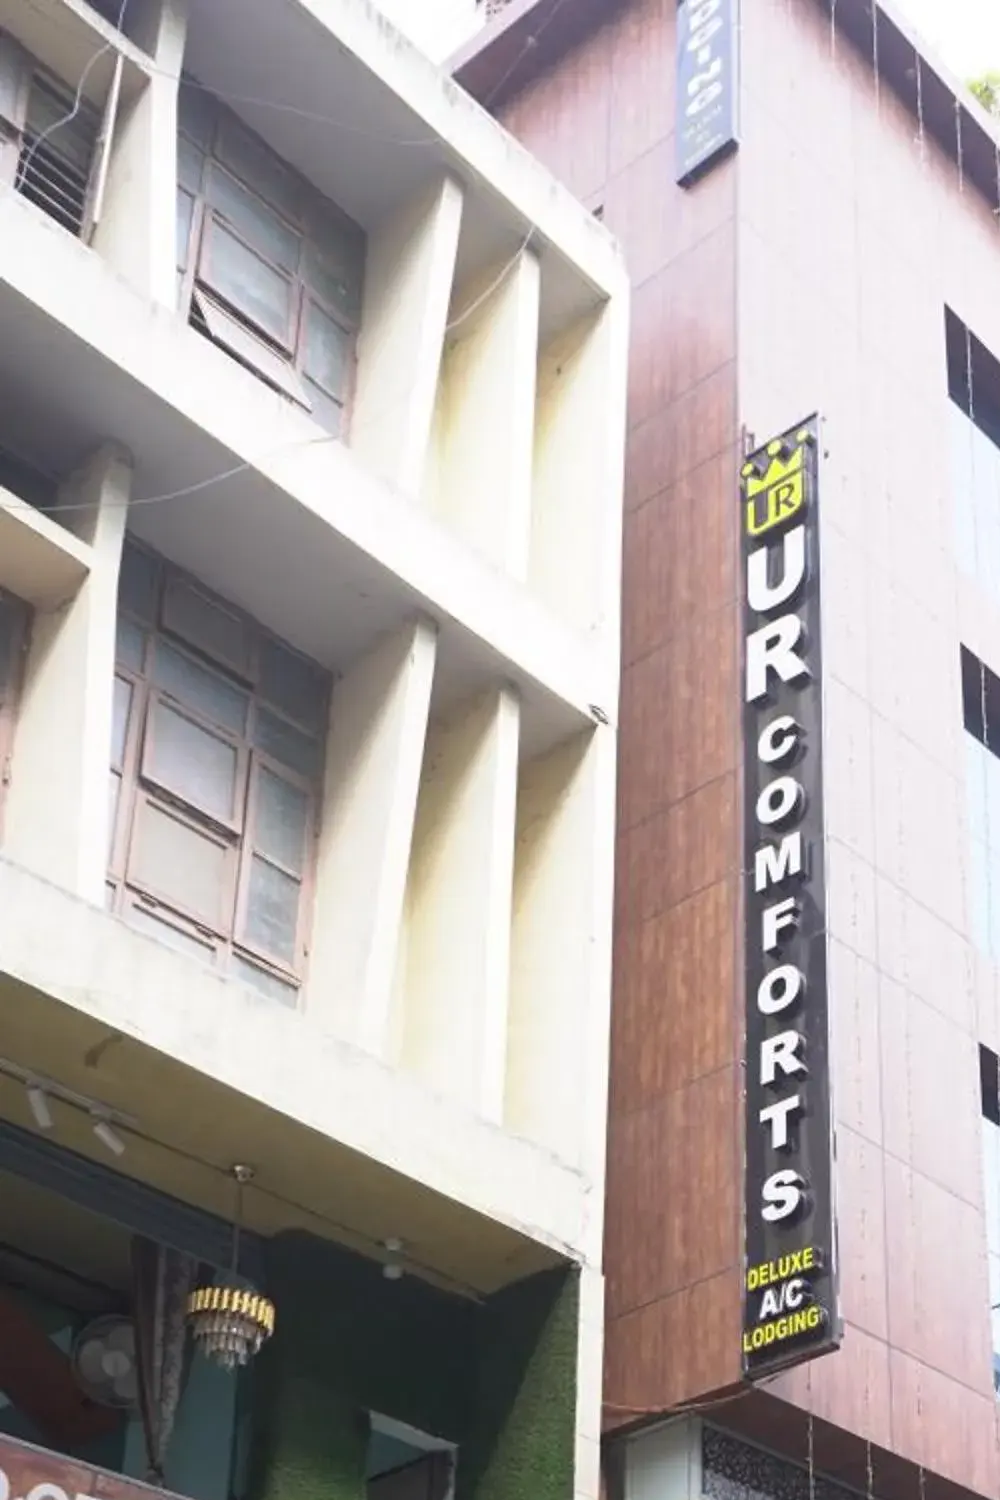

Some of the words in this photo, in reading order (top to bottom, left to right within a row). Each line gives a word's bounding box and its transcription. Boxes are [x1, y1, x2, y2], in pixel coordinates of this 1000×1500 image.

[753, 479, 796, 530] UR
[746, 524, 808, 702] UR
[755, 715, 803, 1222] COMFORTS
[747, 1247, 813, 1291] DELUXE
[760, 1279, 803, 1319] A/C
[743, 1305, 820, 1352] LODGING
